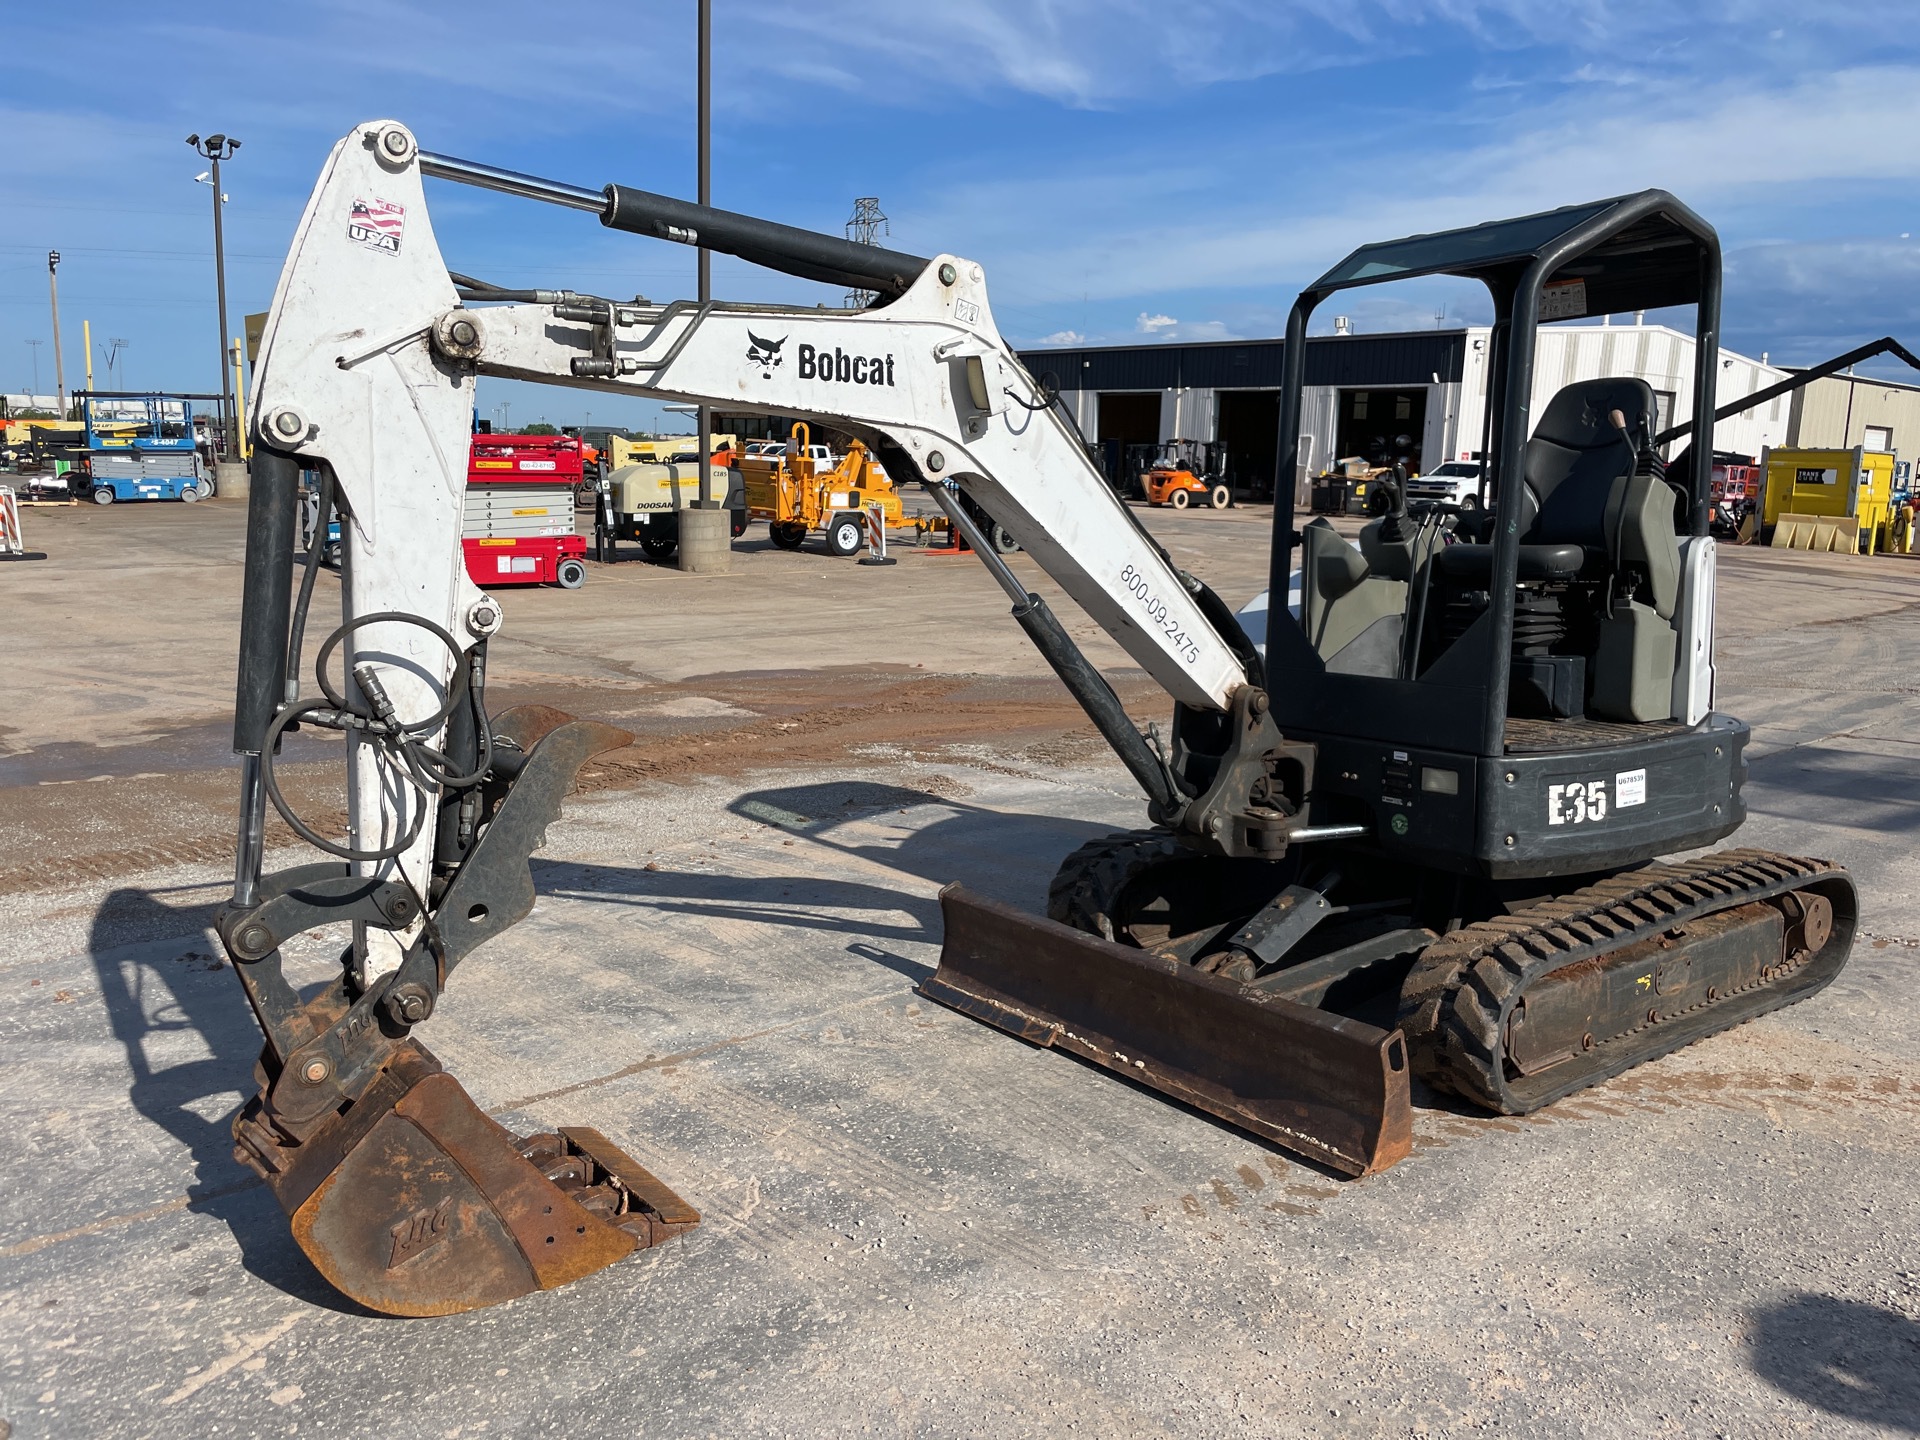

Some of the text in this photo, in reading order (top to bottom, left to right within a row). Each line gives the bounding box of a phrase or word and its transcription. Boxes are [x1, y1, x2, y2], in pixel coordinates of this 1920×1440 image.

[350, 226, 398, 251] USA
[798, 343, 895, 387] Bobcat
[636, 502, 675, 510] DOOSAN
[1120, 564, 1200, 664] 800-09-2475
[1618, 774, 1645, 785] U678539
[1548, 780, 1607, 825] E35
